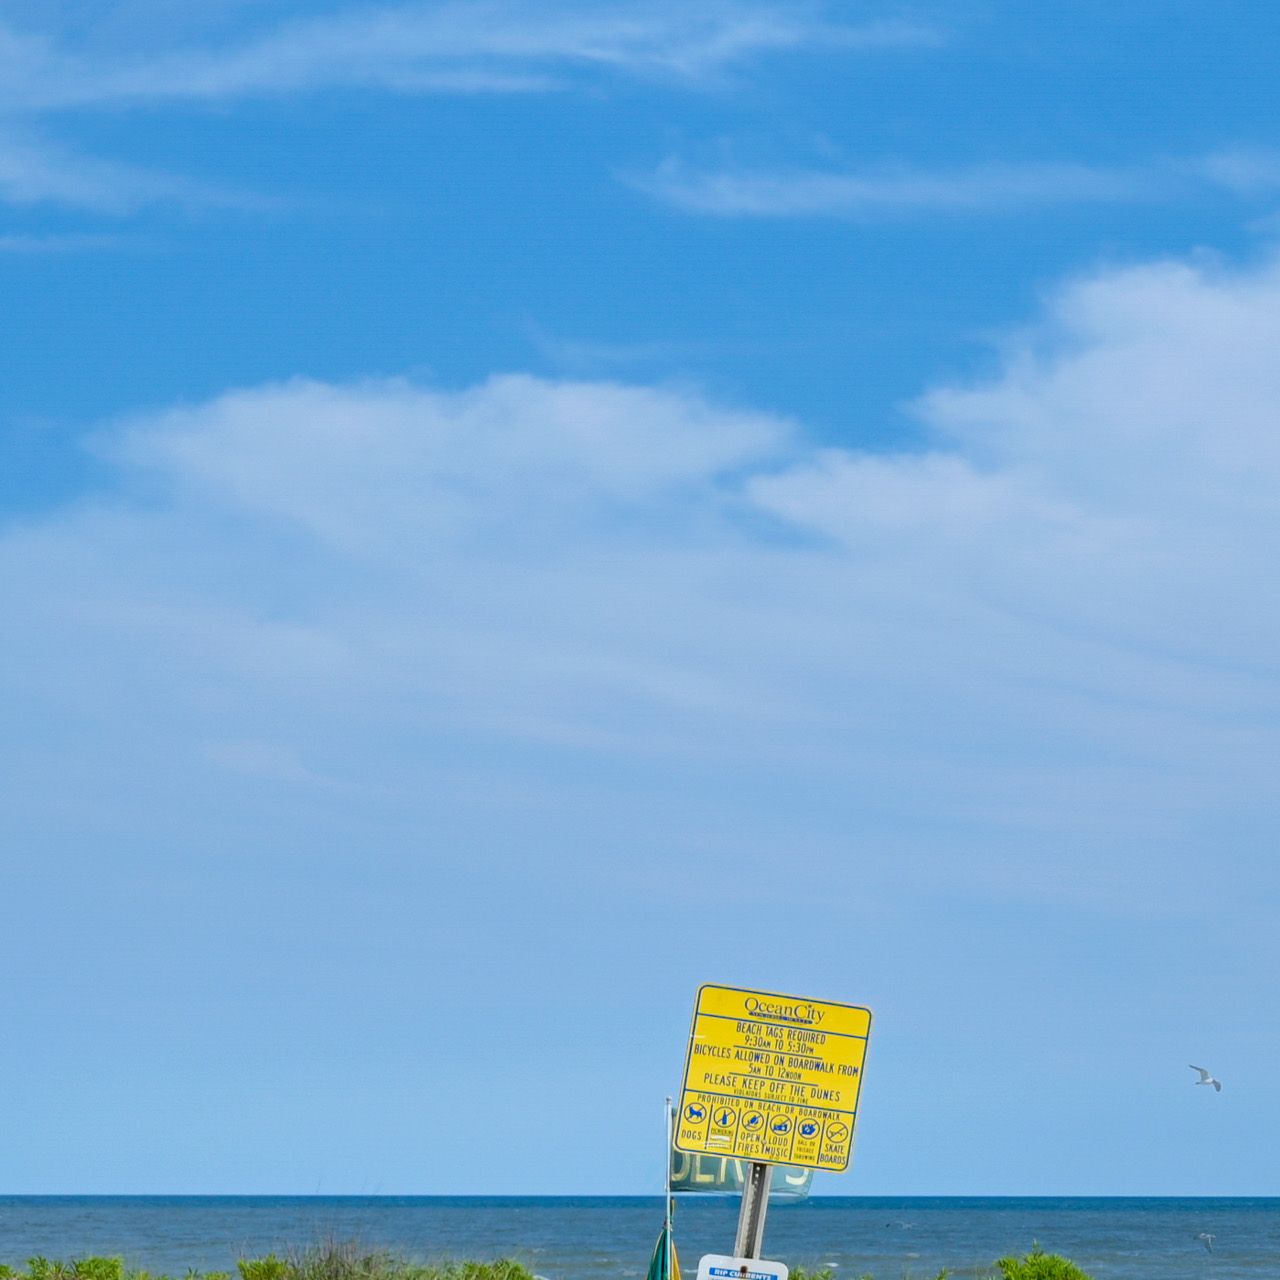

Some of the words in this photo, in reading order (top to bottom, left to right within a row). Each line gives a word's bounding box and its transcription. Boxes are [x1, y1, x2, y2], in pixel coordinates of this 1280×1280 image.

[736, 1022, 761, 1036] BEACH
[765, 1027, 783, 1040] TAGS
[787, 1030, 826, 1045] REQUIRED
[745, 1036, 771, 1048] 9:30AM
[774, 1041, 784, 1050] TO
[788, 1042, 814, 1055] 5:30PM
[694, 1044, 731, 1058] BICYCLES
[735, 1051, 770, 1064] ALLOWED
[774, 1056, 784, 1066] ON
[788, 1058, 834, 1073] BOARDWALK
[838, 1065, 858, 1076] FROM
[749, 1064, 761, 1073] 5AM
[765, 1066, 774, 1075] TO
[704, 1073, 737, 1087] PLEASE
[742, 1078, 765, 1090] KEEP
[769, 1082, 786, 1093] OFF
[790, 1085, 806, 1097] THE
[811, 1088, 840, 1102] DUNES
[698, 1094, 740, 1108] PROHIBITED
[744, 1100, 754, 1109] ON
[758, 1102, 780, 1113] BEACH
[783, 1105, 795, 1114] OR
[799, 1107, 840, 1120] BOARDWALK
[682, 1130, 702, 1140] DOGS
[741, 1132, 761, 1143] OPEN
[769, 1137, 788, 1146] LOUD
[738, 1143, 759, 1155] FIRES
[764, 1146, 788, 1158] MUSIC
[824, 1144, 843, 1153] SKATE
[820, 1153, 845, 1165] BOARDS
